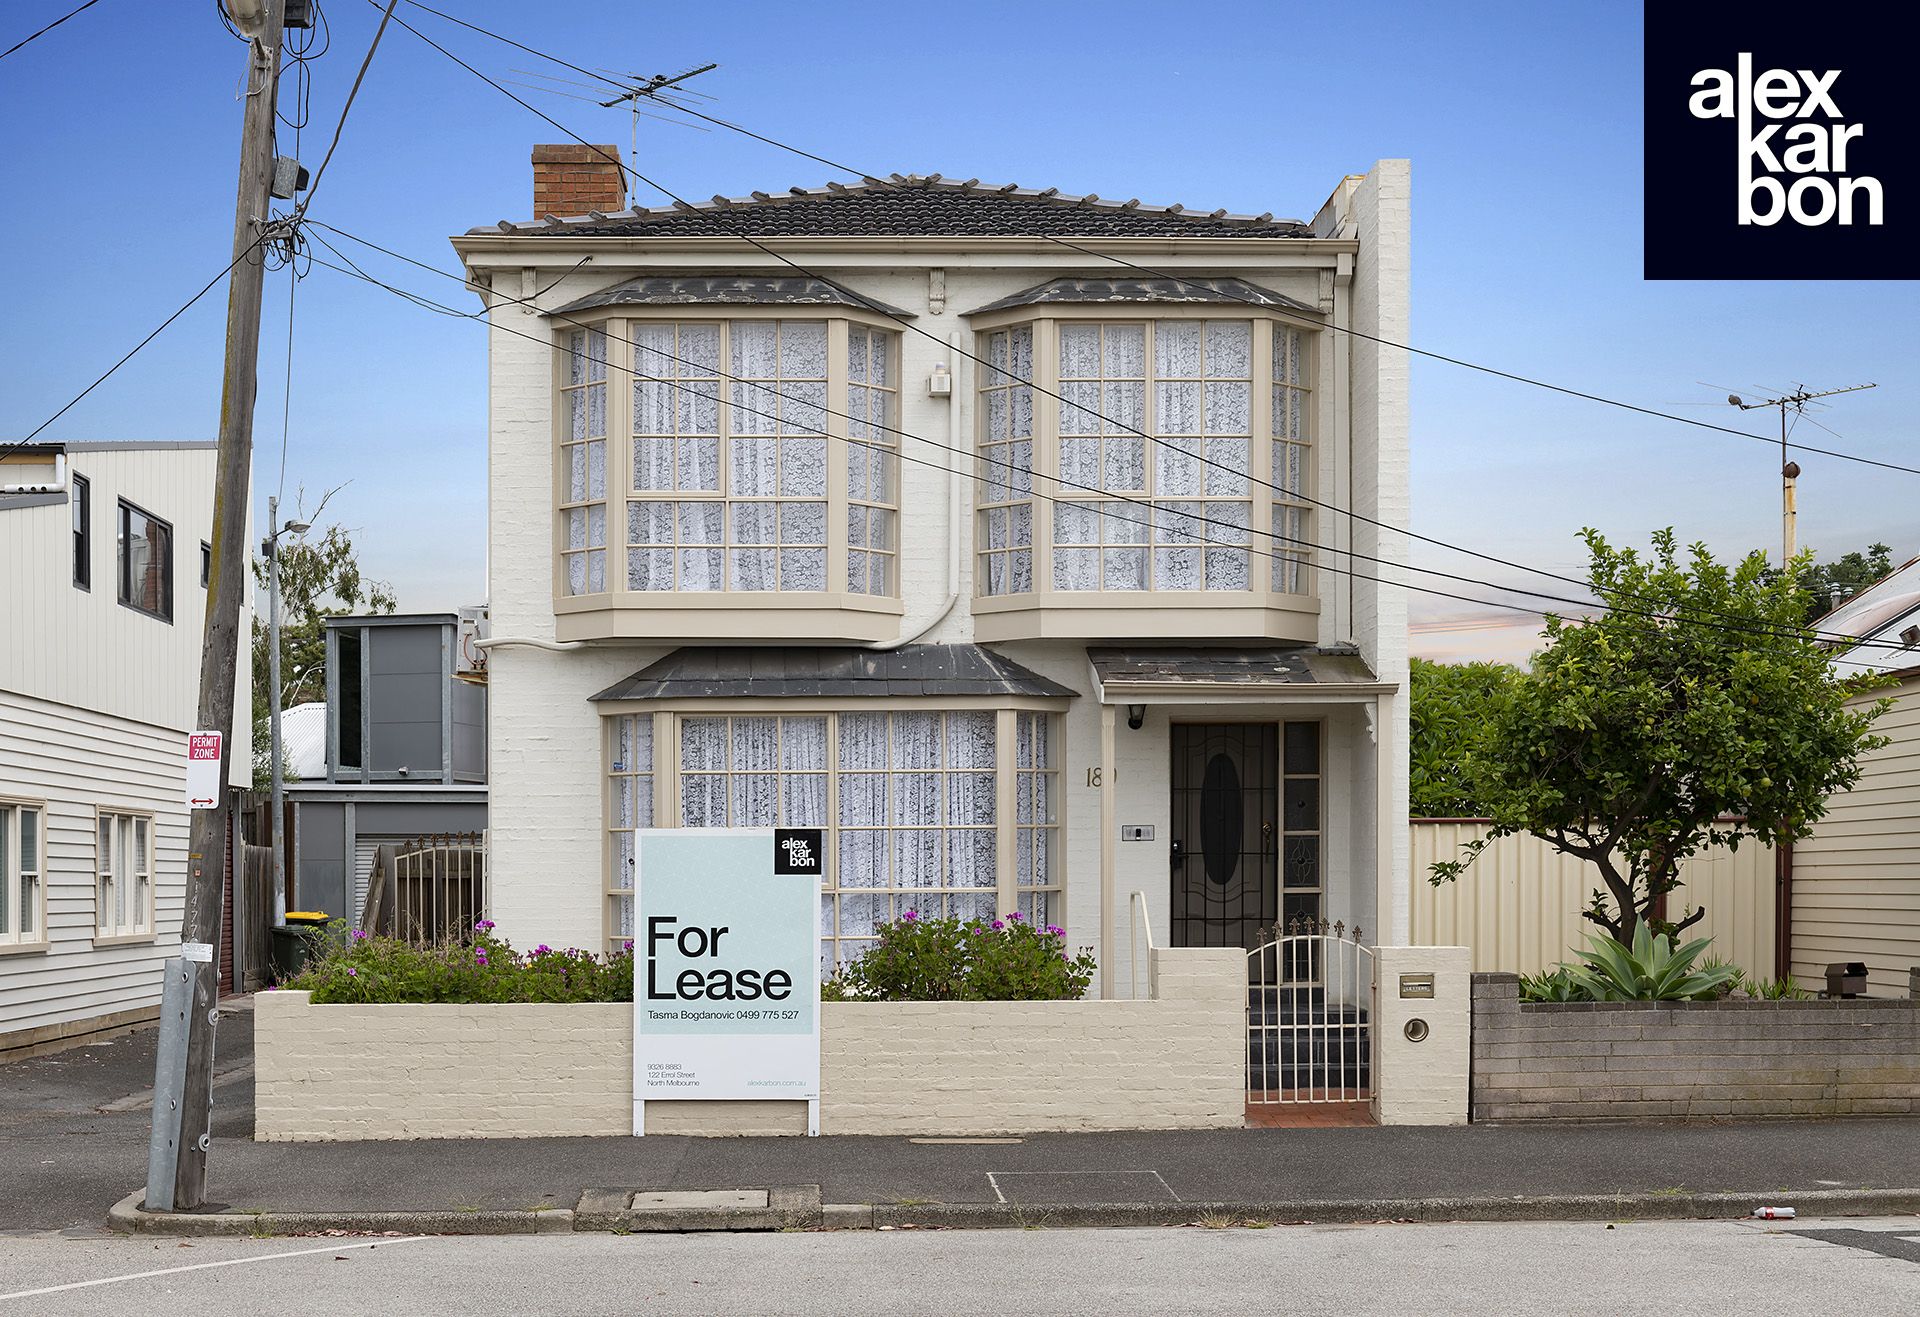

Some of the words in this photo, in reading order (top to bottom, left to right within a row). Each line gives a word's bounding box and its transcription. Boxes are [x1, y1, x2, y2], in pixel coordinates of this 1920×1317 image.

[192, 737, 218, 747] PERMIT
[193, 748, 215, 759] ZONE
[1086, 767, 1117, 787] 18
[781, 837, 808, 849] alex
[790, 848, 812, 858] kar
[790, 857, 815, 867] bon
[647, 916, 729, 958] For
[647, 958, 792, 1001] Lease
[648, 1010, 679, 1020] Tasma
[680, 1010, 735, 1021] Bogdanovic
[736, 1010, 760, 1019] 0499
[762, 1010, 780, 1019] 775
[781, 1010, 799, 1019] 527
[747, 1079, 807, 1087] alexkarbon.com.au
